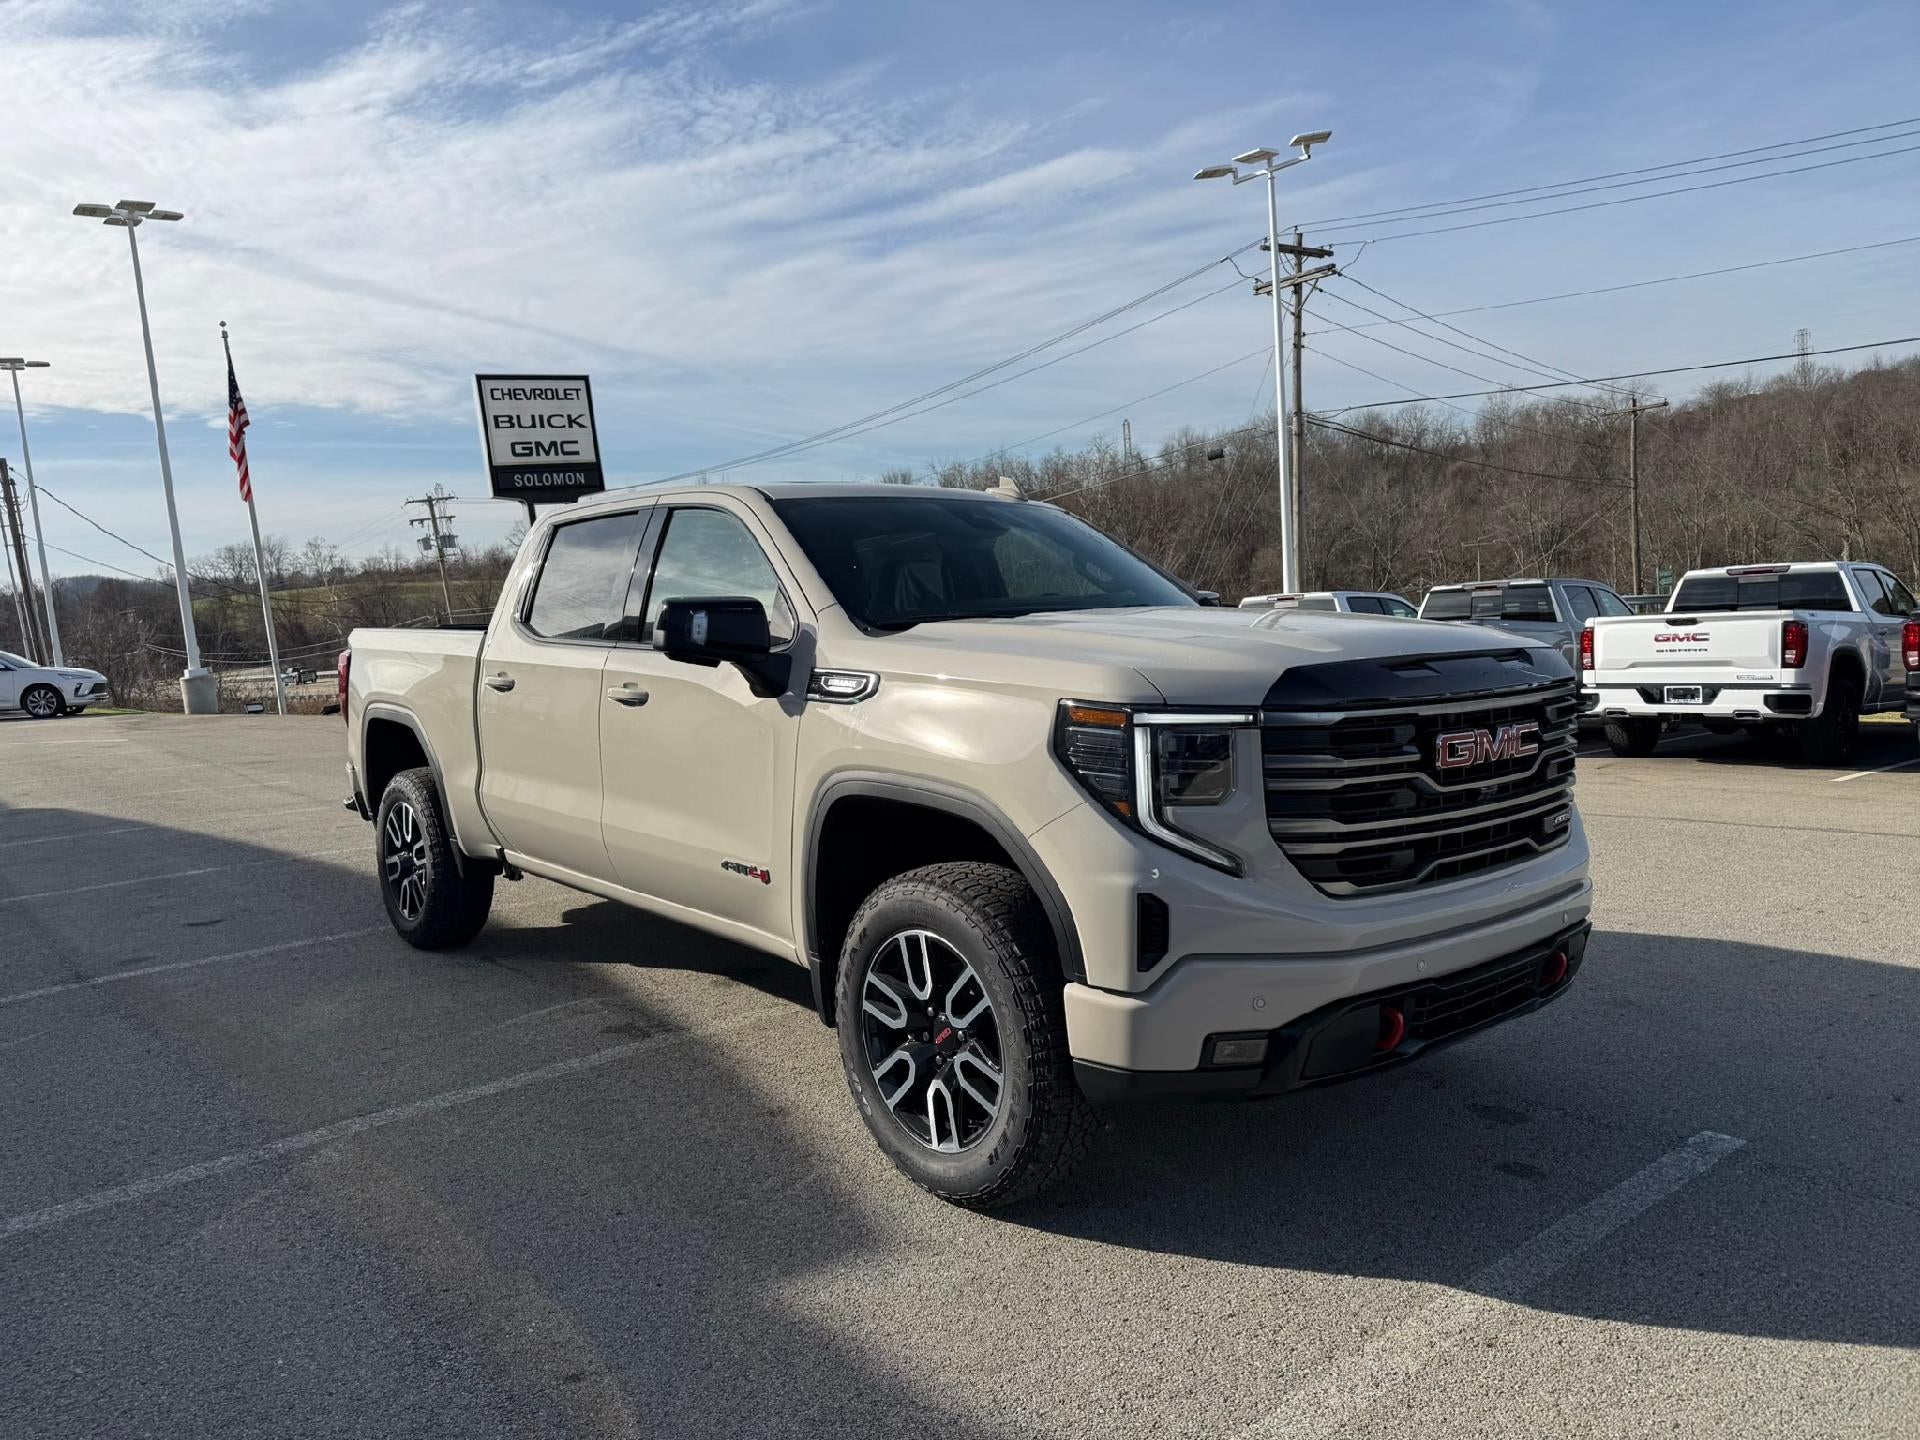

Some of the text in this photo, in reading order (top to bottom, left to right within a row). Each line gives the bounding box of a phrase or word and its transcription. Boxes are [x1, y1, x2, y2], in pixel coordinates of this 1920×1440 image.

[490, 388, 582, 401] CHEVROLET
[493, 413, 588, 429] BUICK
[510, 440, 580, 457] GMC
[513, 472, 585, 487] SOLOMON
[1654, 632, 1710, 643] GMC
[1436, 721, 1539, 769] GMC
